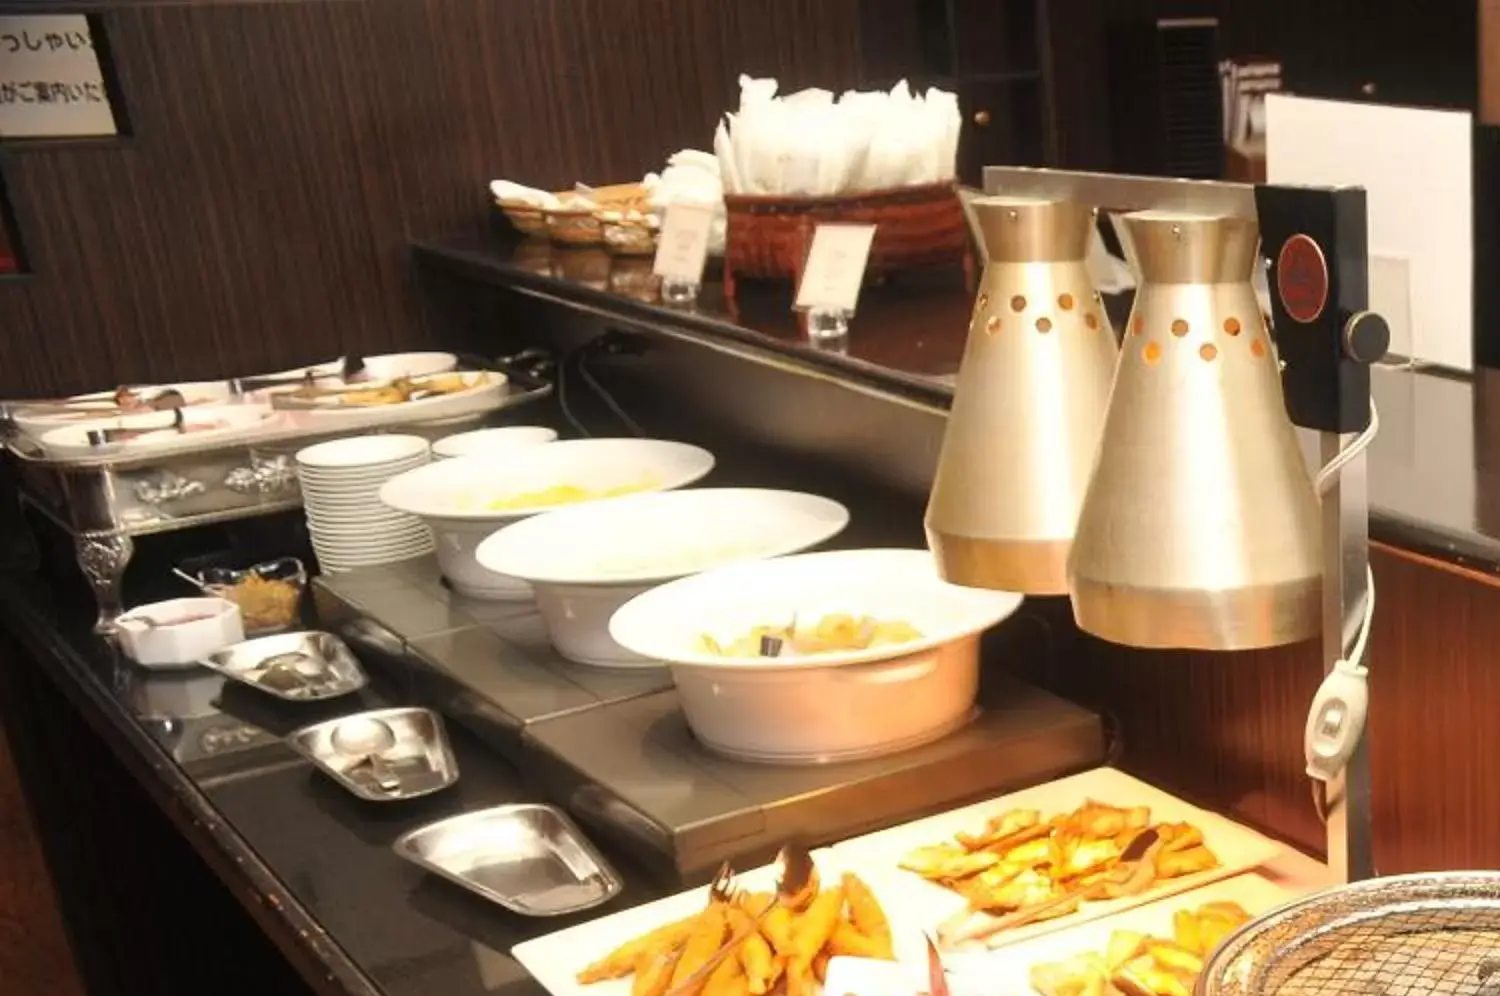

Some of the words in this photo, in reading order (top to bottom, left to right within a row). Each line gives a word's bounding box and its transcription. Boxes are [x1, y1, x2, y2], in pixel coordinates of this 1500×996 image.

[0, 80, 102, 105] がご案内いた
